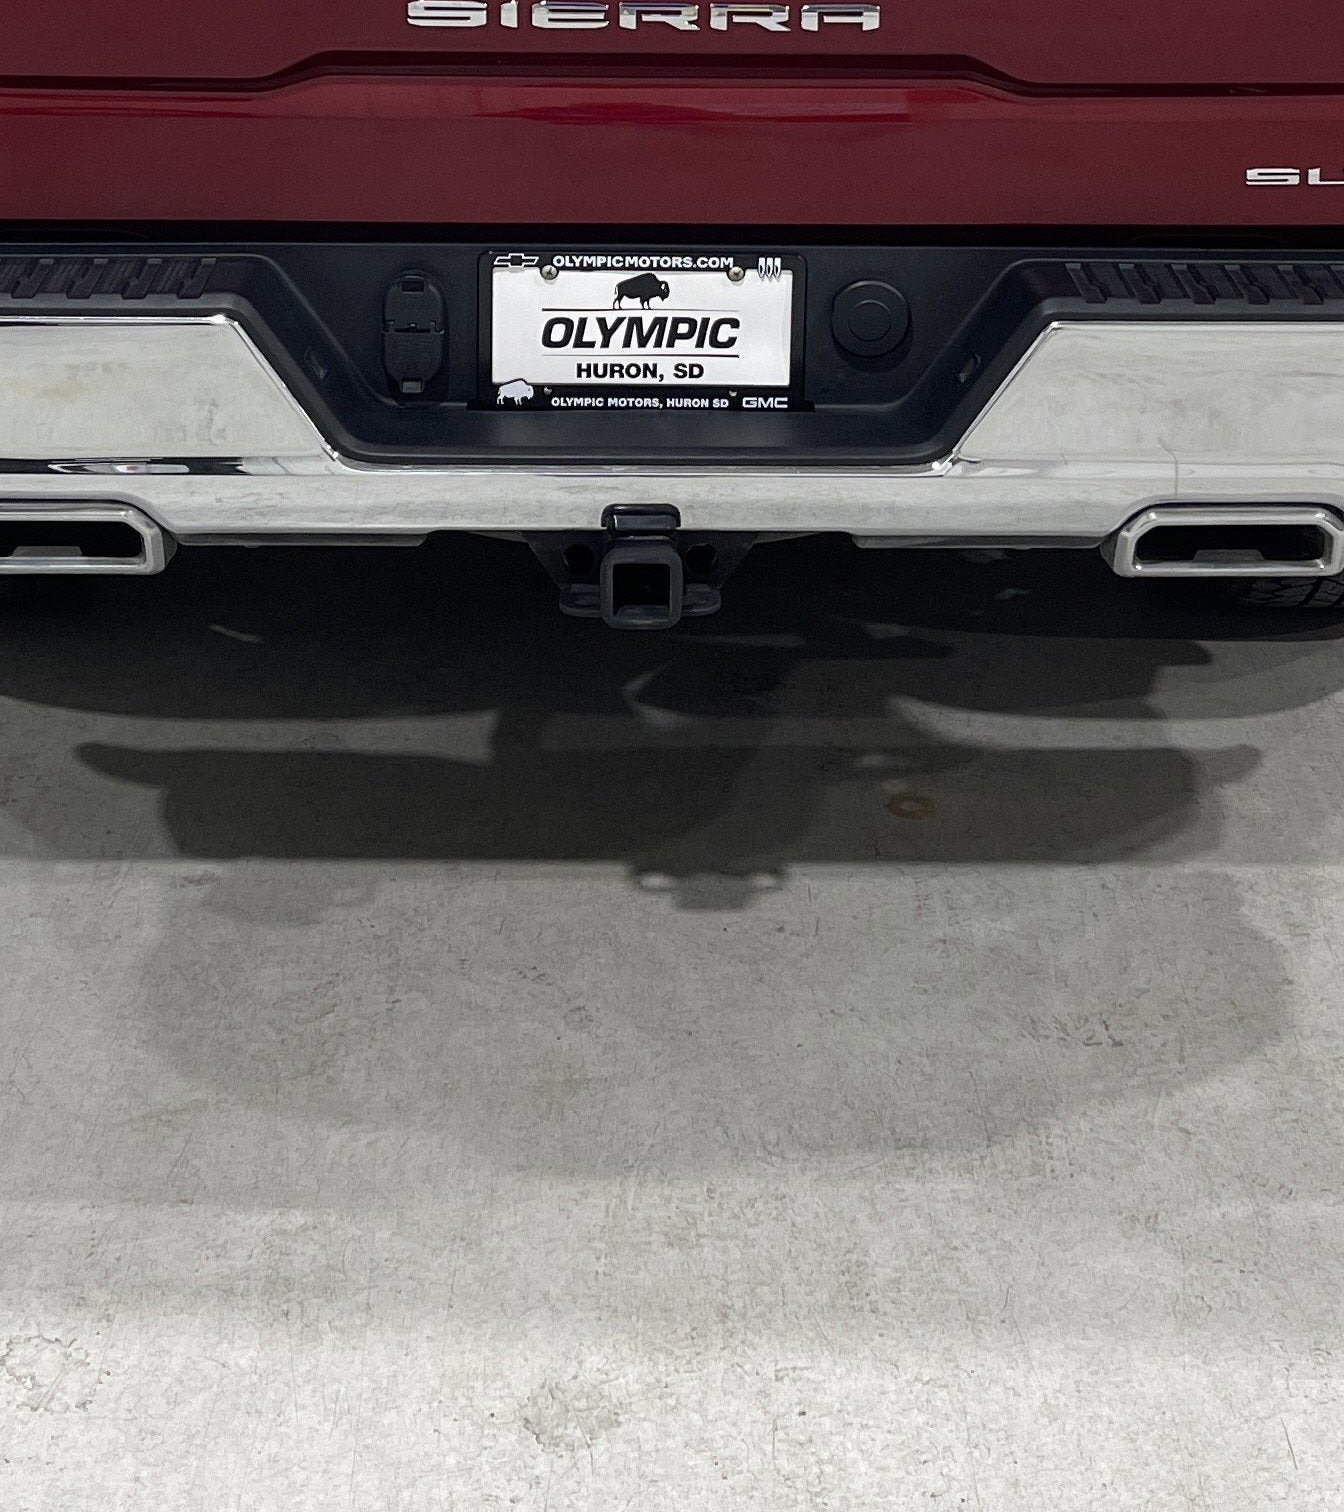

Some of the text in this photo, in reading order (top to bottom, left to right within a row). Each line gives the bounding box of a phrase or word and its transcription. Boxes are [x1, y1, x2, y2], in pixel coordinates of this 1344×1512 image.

[552, 255, 734, 269] OLYMPICMOTORS.COM
[541, 316, 741, 349] OLYMPIC
[576, 363, 705, 382] HURON, SD
[551, 397, 729, 409] OLYMPIC MOTORS, HURON SD
[742, 397, 789, 409] GMC
